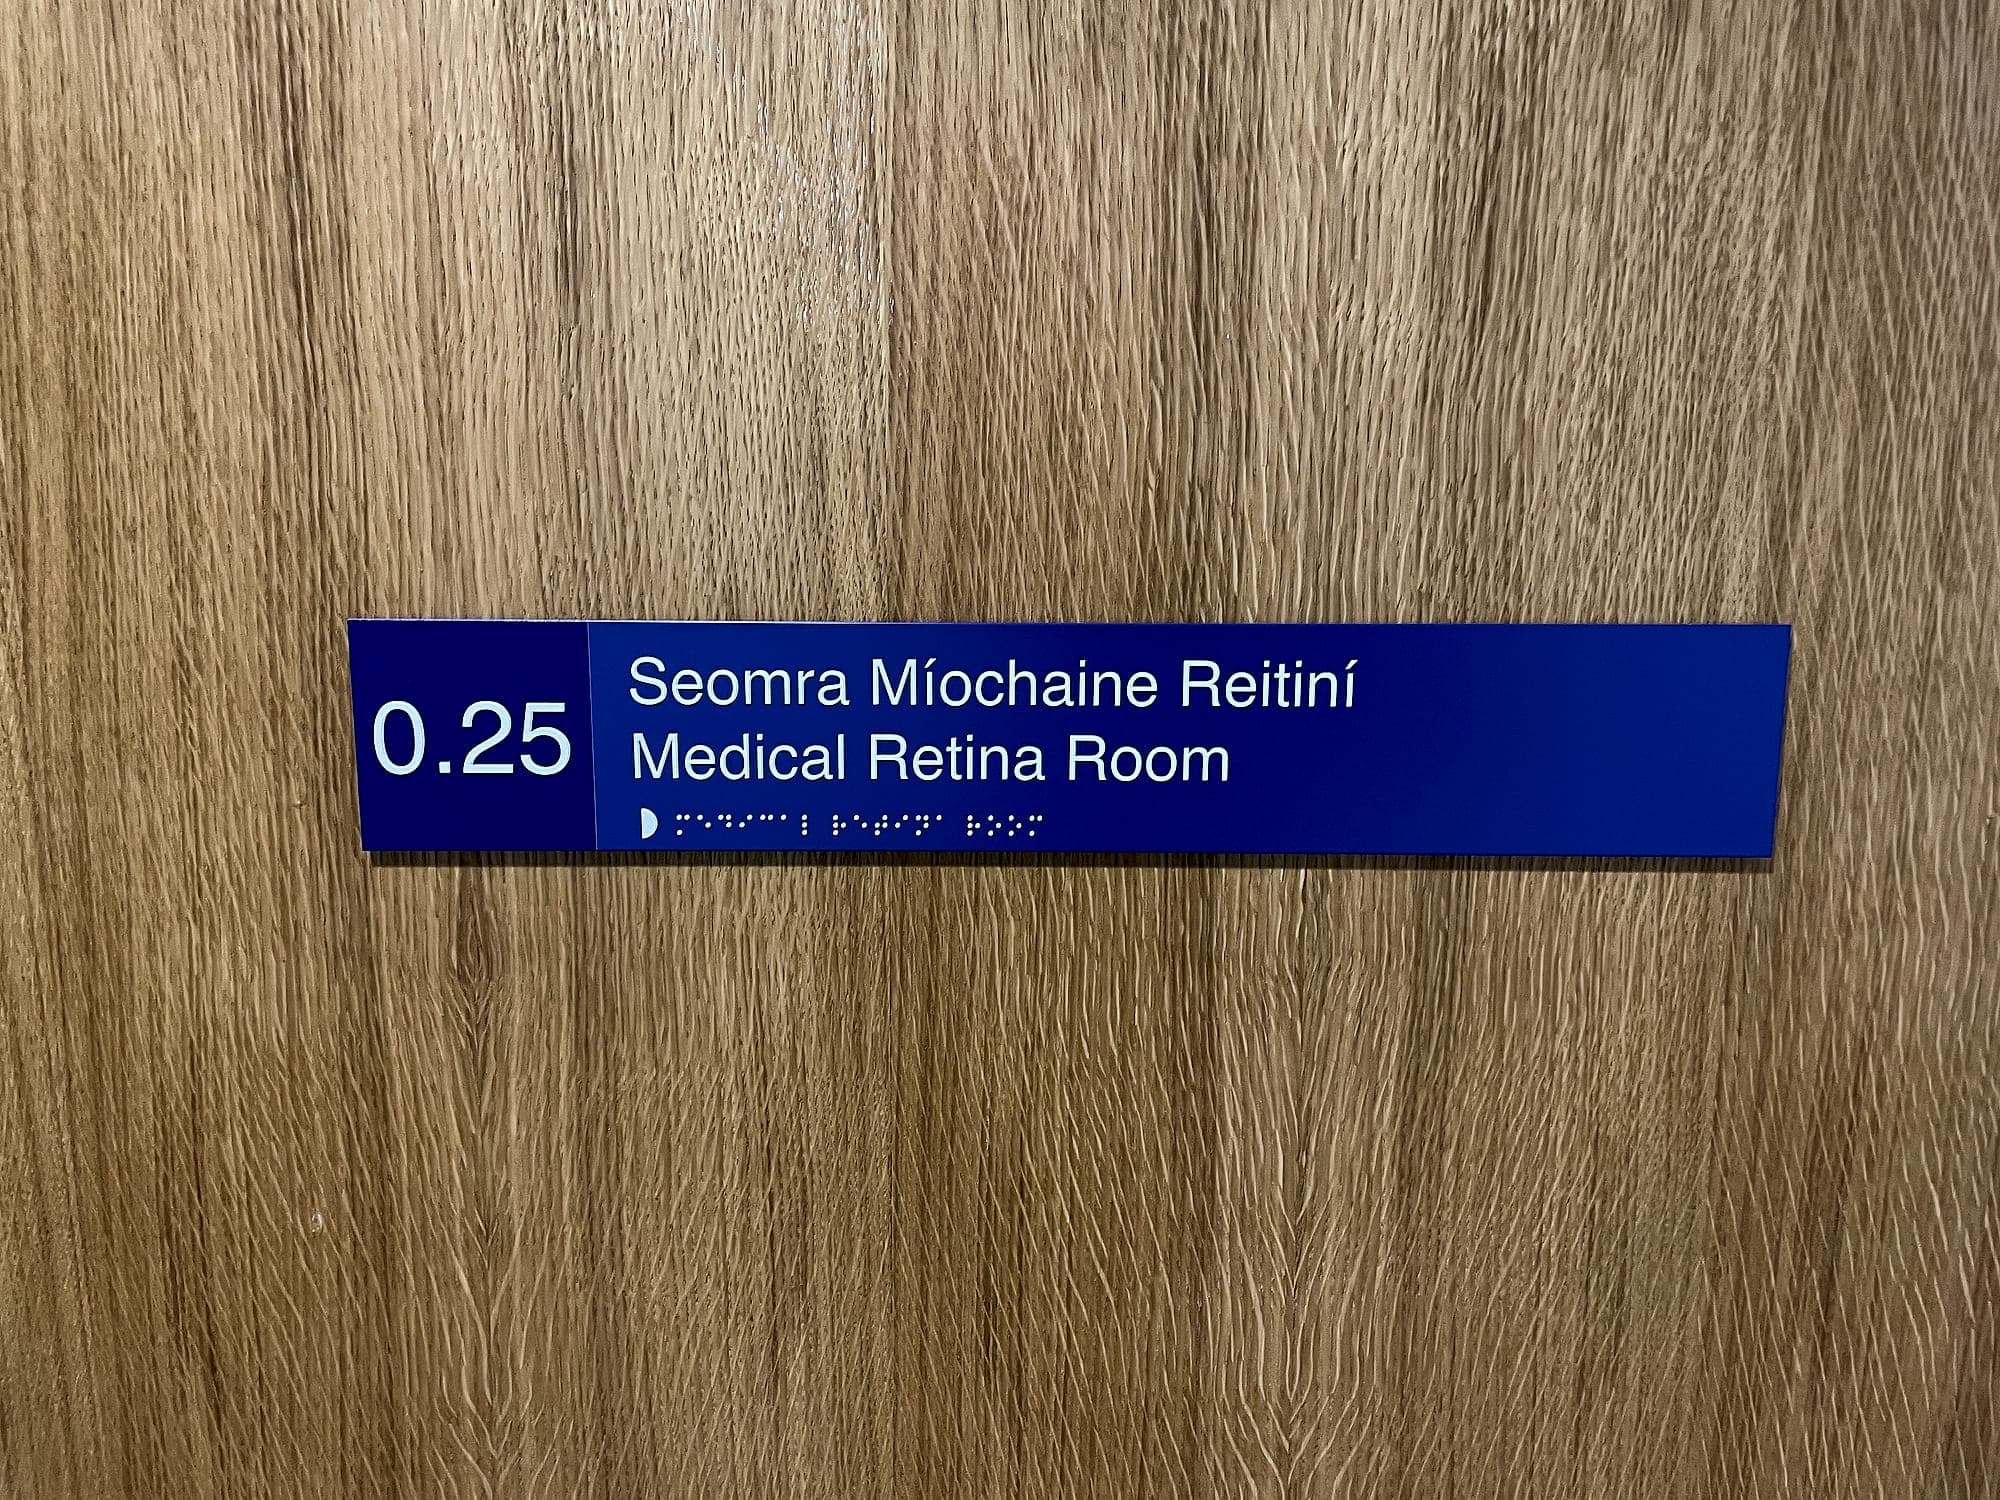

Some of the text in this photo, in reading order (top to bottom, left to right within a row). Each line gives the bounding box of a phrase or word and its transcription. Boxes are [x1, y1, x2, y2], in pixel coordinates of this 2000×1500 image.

[629, 656, 1358, 708] Seomra Míochaine Reitiní
[373, 700, 571, 776] 0.25
[632, 732, 1229, 782] Medical Retina Room
